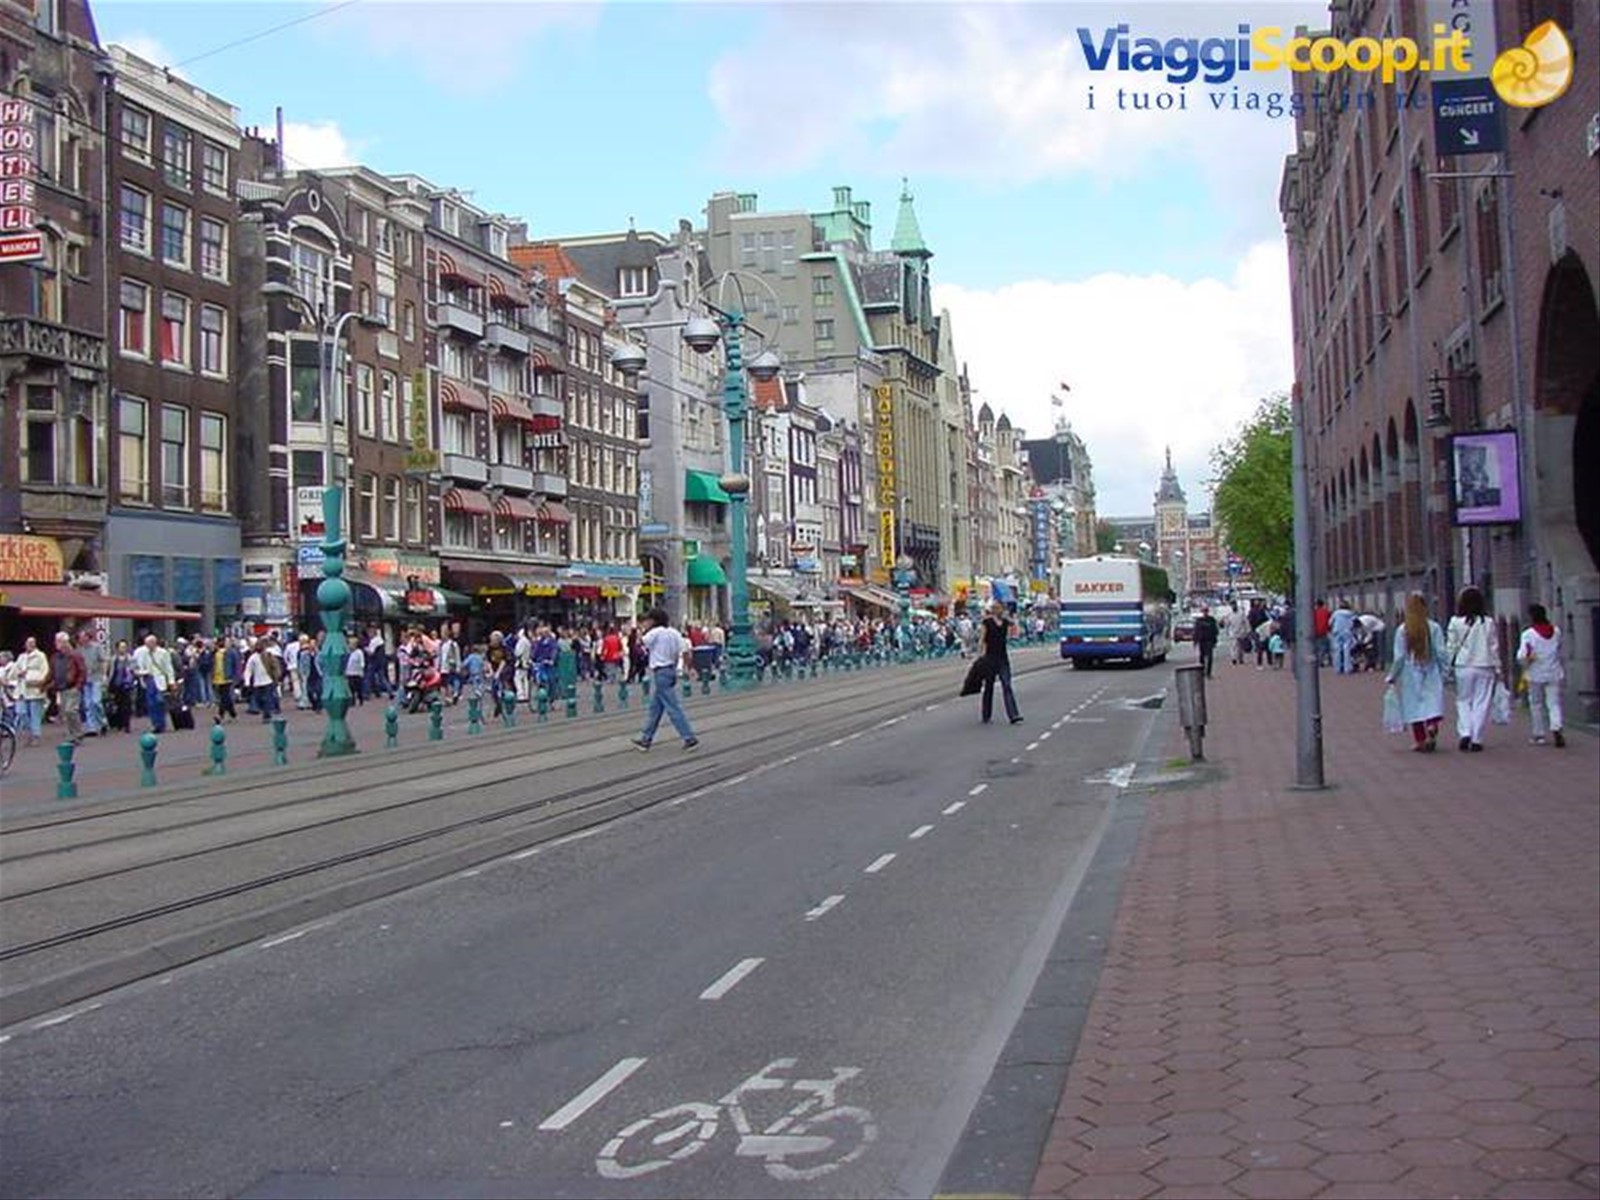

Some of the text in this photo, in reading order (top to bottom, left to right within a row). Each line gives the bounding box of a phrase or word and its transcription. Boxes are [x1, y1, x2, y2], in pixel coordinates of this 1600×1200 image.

[1440, 102, 1495, 116] CONCERT
[3, 104, 20, 228] HOTEL
[1074, 582, 1124, 594] BAKKER
